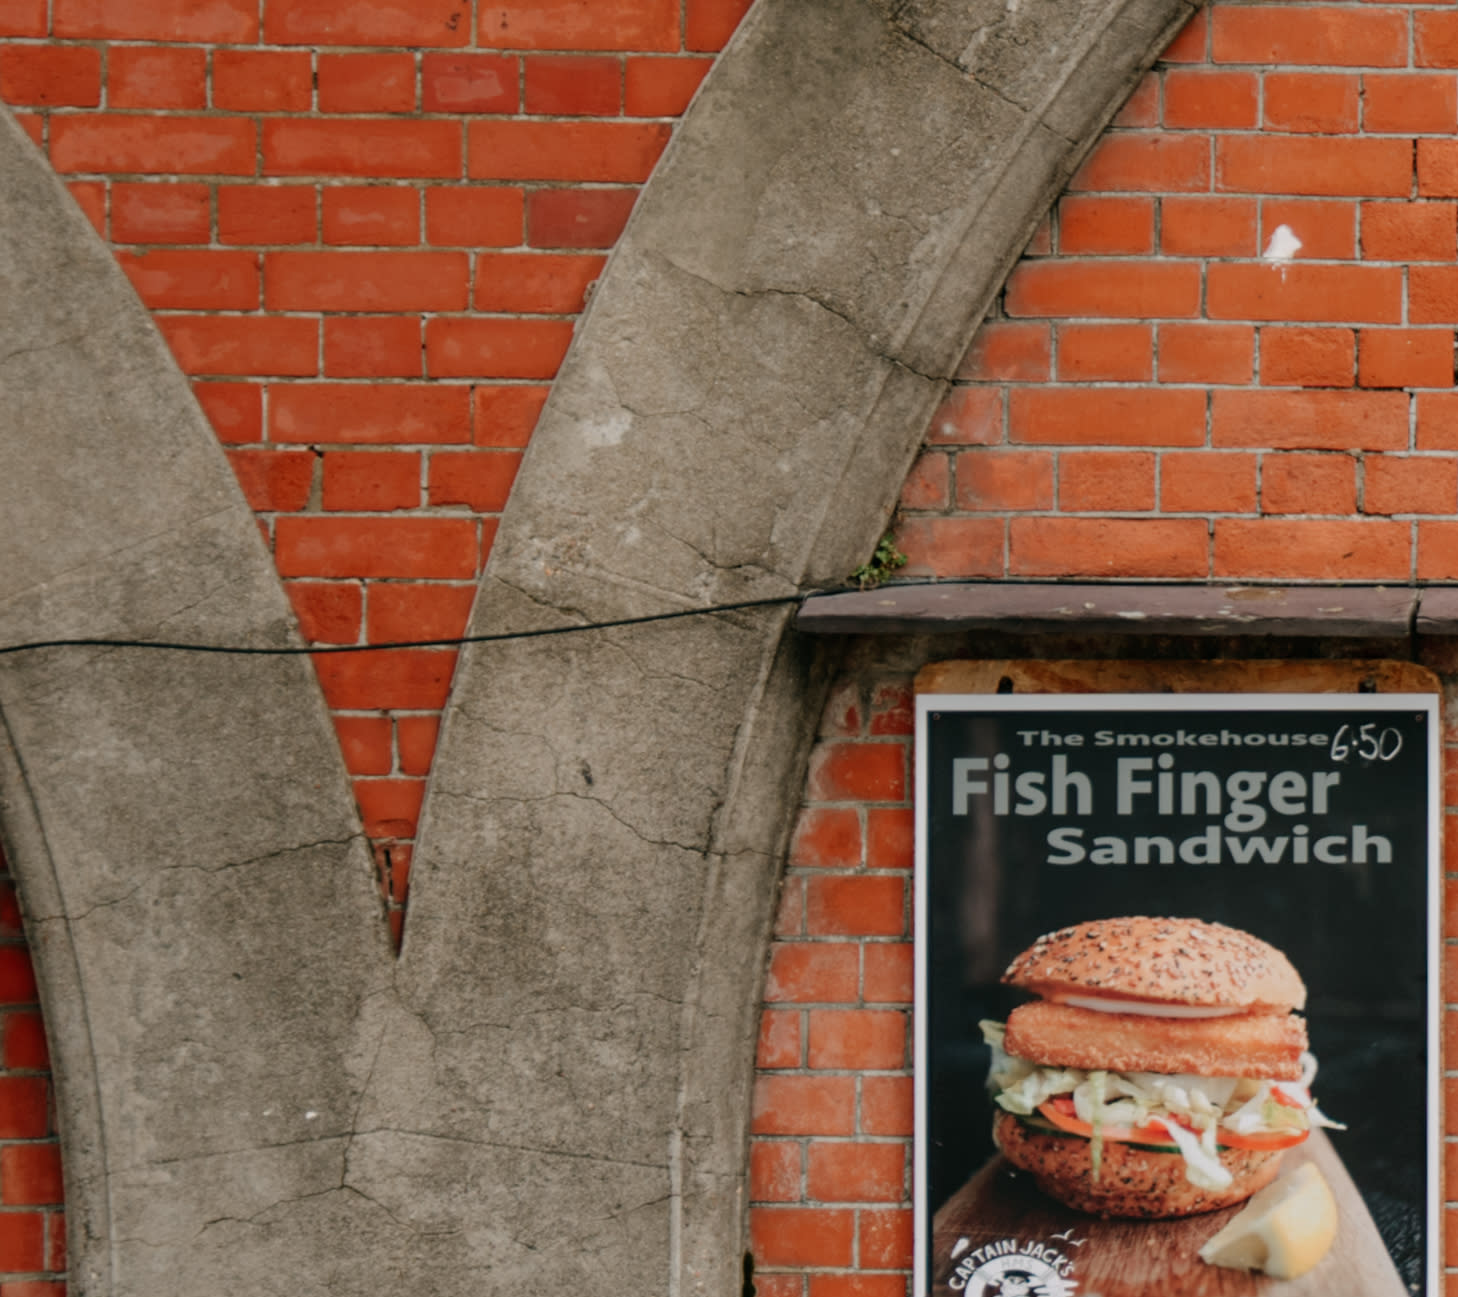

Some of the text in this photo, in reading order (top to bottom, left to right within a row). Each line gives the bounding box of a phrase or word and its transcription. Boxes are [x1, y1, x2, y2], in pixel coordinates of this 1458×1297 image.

[1017, 730, 1329, 746] The Smokehouse
[952, 753, 1340, 832] Fish Finger
[1046, 826, 1393, 865] Sandwich
[949, 1239, 1075, 1290] CAPTAIN JACK'S
